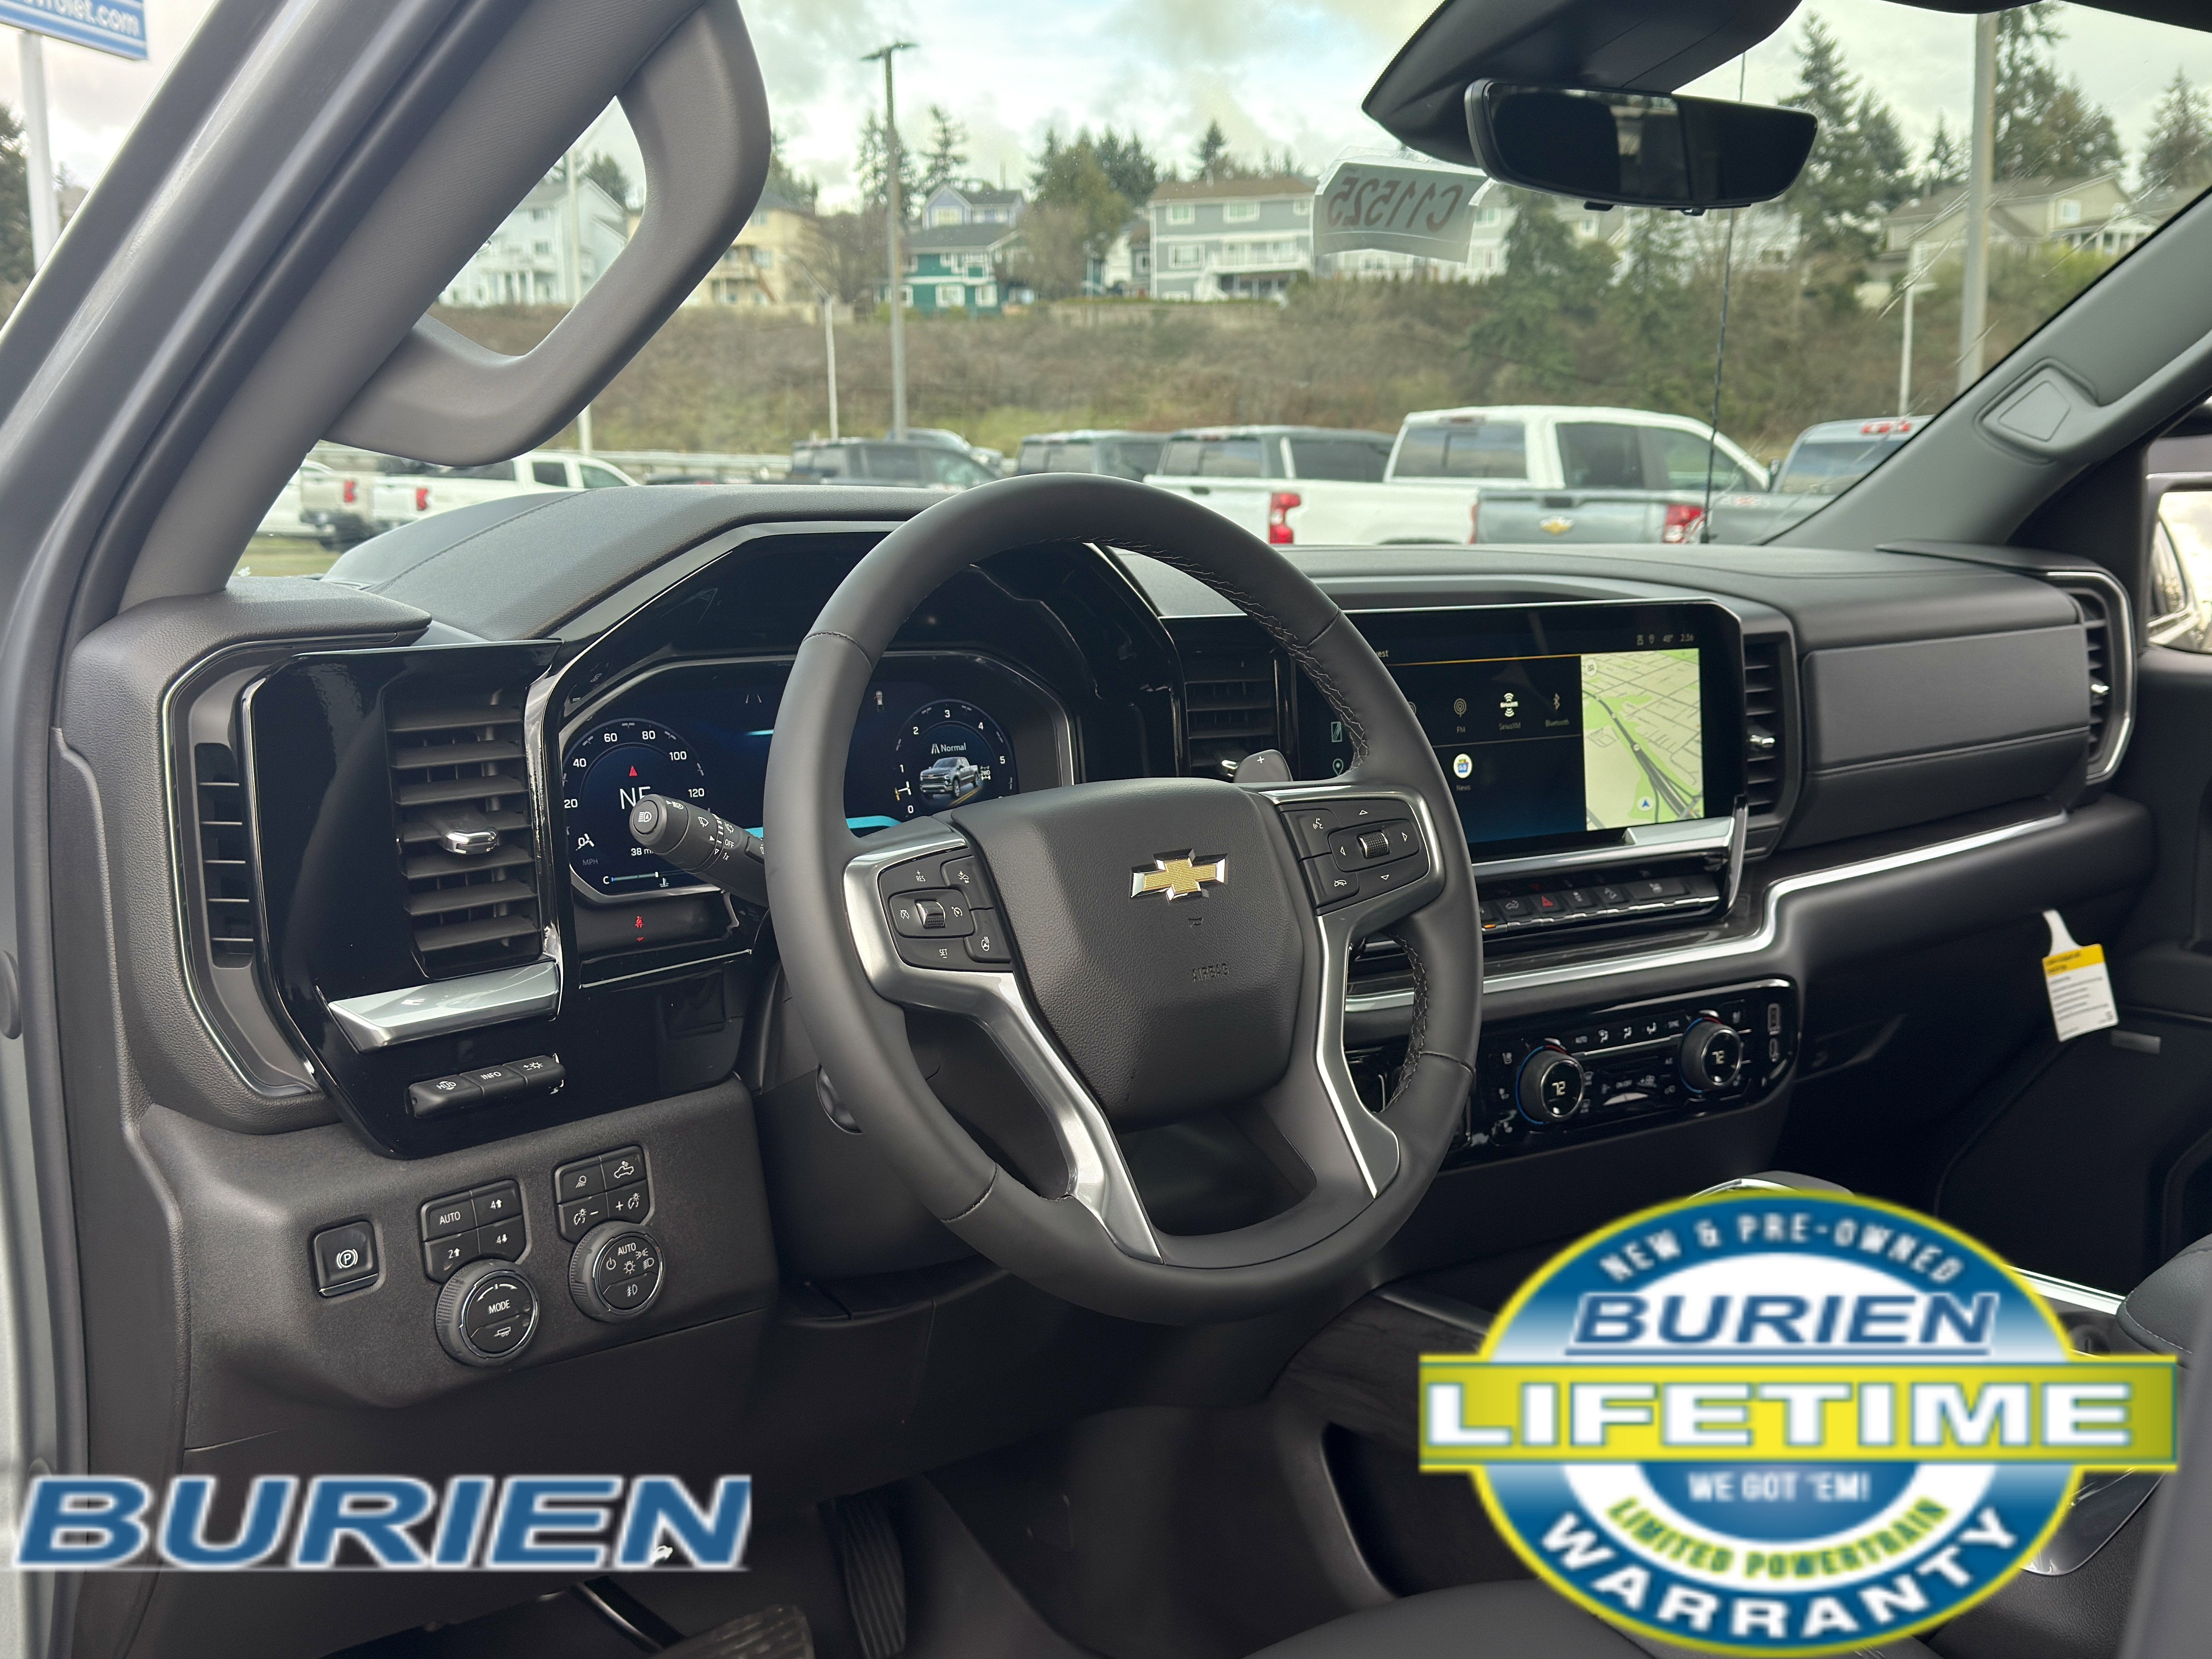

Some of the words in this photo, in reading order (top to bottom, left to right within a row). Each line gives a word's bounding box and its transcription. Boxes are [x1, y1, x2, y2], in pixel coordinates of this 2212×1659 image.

[945, 710, 950, 718] 3
[913, 726, 919, 735] 2
[978, 722, 984, 730] 4
[604, 733, 617, 742] 60
[642, 731, 656, 740] 80
[941, 742, 966, 752] Normal
[669, 751, 687, 761] 100
[1000, 756, 1005, 764] 5
[573, 758, 586, 768] 40
[900, 764, 904, 773] 1
[689, 788, 704, 797] 120
[564, 799, 578, 809] 20
[908, 805, 914, 813] 0
[578, 837, 585, 847] 0
[725, 839, 734, 848] OFF
[631, 848, 642, 856] 38
[723, 852, 729, 861] 1x
[603, 876, 610, 884] C
[1712, 1050, 1725, 1065] 72
[481, 1071, 502, 1080] INFO
[436, 1081, 457, 1090] HUD
[1552, 1081, 1566, 1096] 72
[439, 1211, 461, 1225] AUTO
[618, 1242, 636, 1256] AUTO
[488, 1299, 510, 1314] MODE
